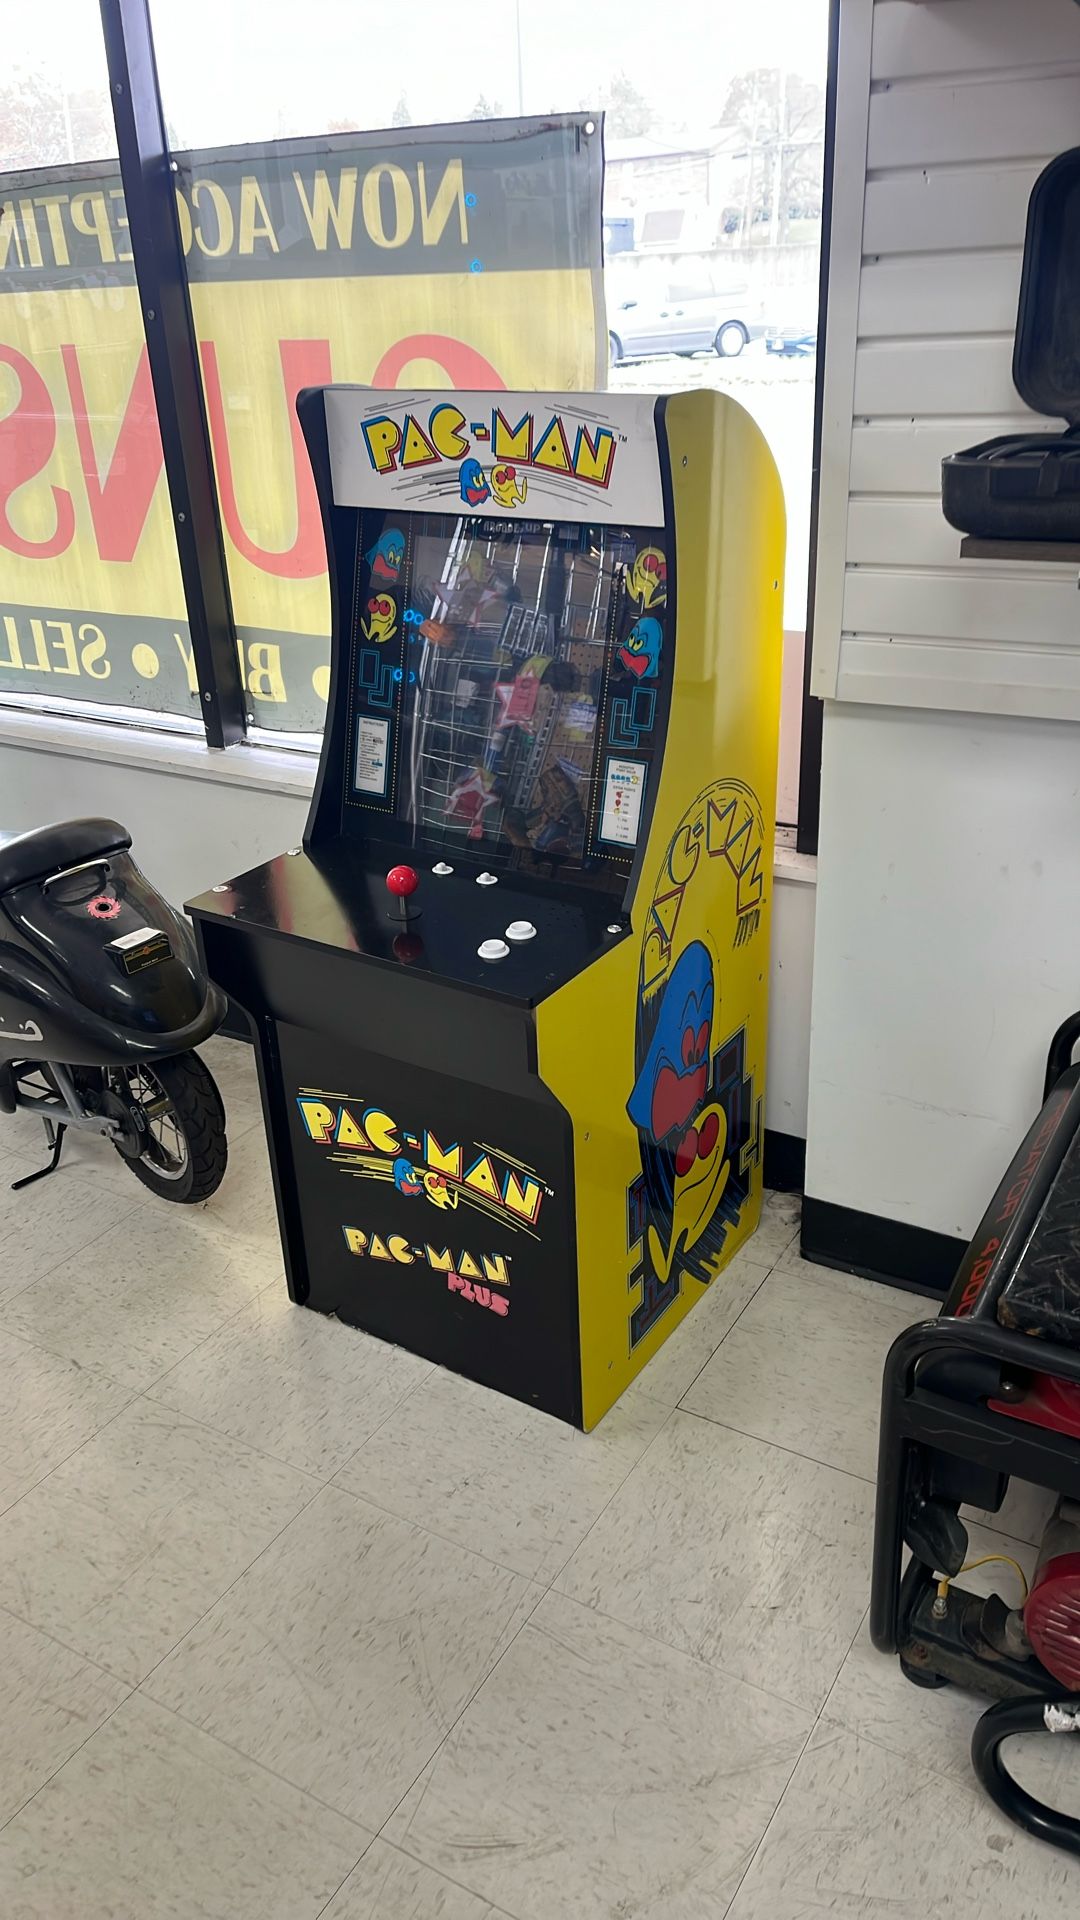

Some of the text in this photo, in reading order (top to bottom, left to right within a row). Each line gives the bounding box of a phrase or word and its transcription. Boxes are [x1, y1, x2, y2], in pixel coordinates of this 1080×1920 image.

[360, 402, 617, 489] PAC-MAN
[642, 797, 763, 994] PAC-MAN
[296, 1097, 543, 1224] PAC-MAN
[342, 1225, 511, 1287] PAC-MAN
[447, 1272, 510, 1317] PLUS
